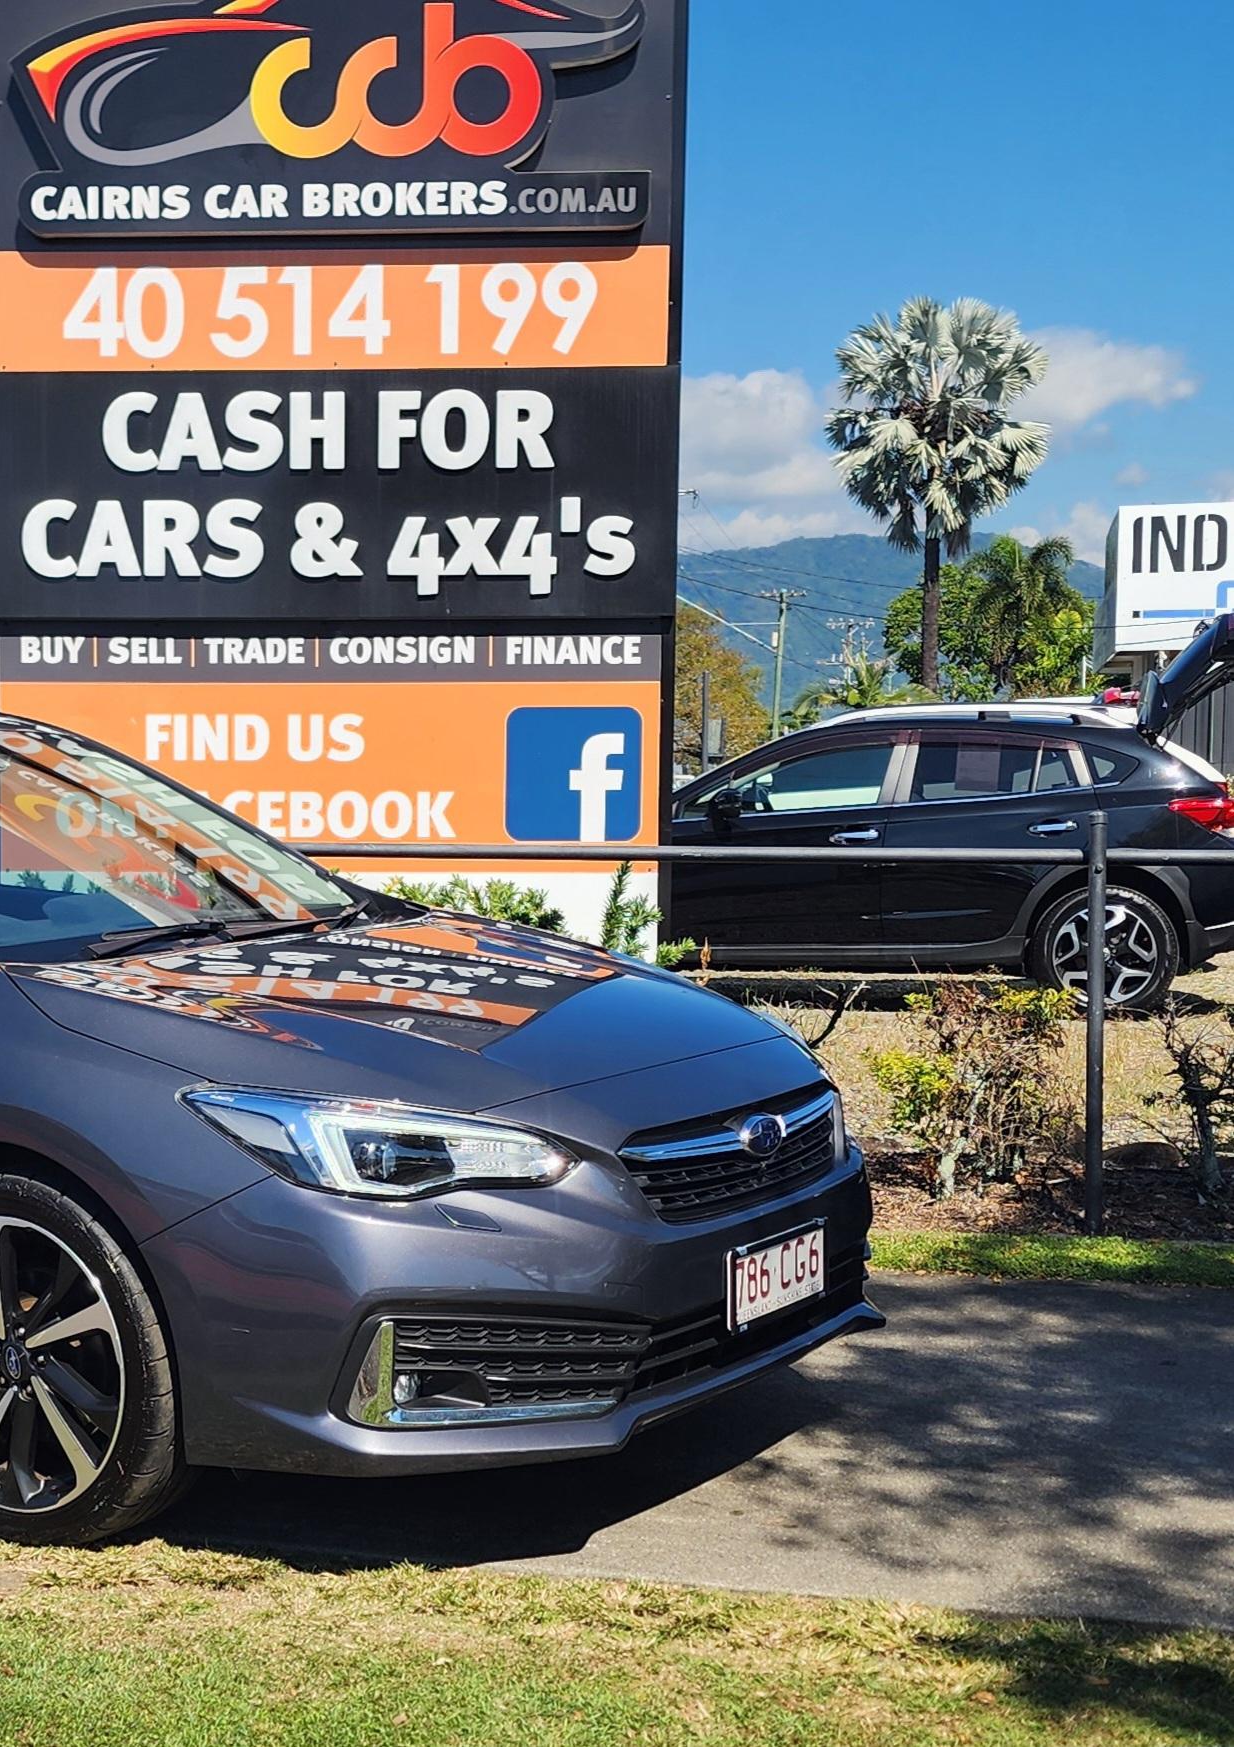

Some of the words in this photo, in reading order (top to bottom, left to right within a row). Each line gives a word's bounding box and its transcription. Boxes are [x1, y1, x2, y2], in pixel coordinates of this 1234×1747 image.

[30, 184, 191, 221] CAIRNS
[204, 183, 289, 219] CAR
[62, 265, 185, 359] 40
[209, 264, 391, 358] 514
[424, 261, 598, 355] 199
[103, 390, 346, 473] CASH
[377, 388, 555, 470] FOR
[21, 498, 264, 579] CARS
[290, 502, 363, 578] &
[1131, 514, 1228, 573] IND
[20, 636, 86, 665] BUY
[107, 637, 183, 665] SELL
[203, 637, 306, 665] TRADE
[329, 635, 476, 664] CONSIGN
[506, 636, 642, 665] FINANCE
[145, 713, 270, 762] FIND
[287, 713, 366, 762] US
[190, 789, 457, 839] CEBOOK
[736, 1253, 770, 1309] 786
[781, 1234, 819, 1290] CG6
